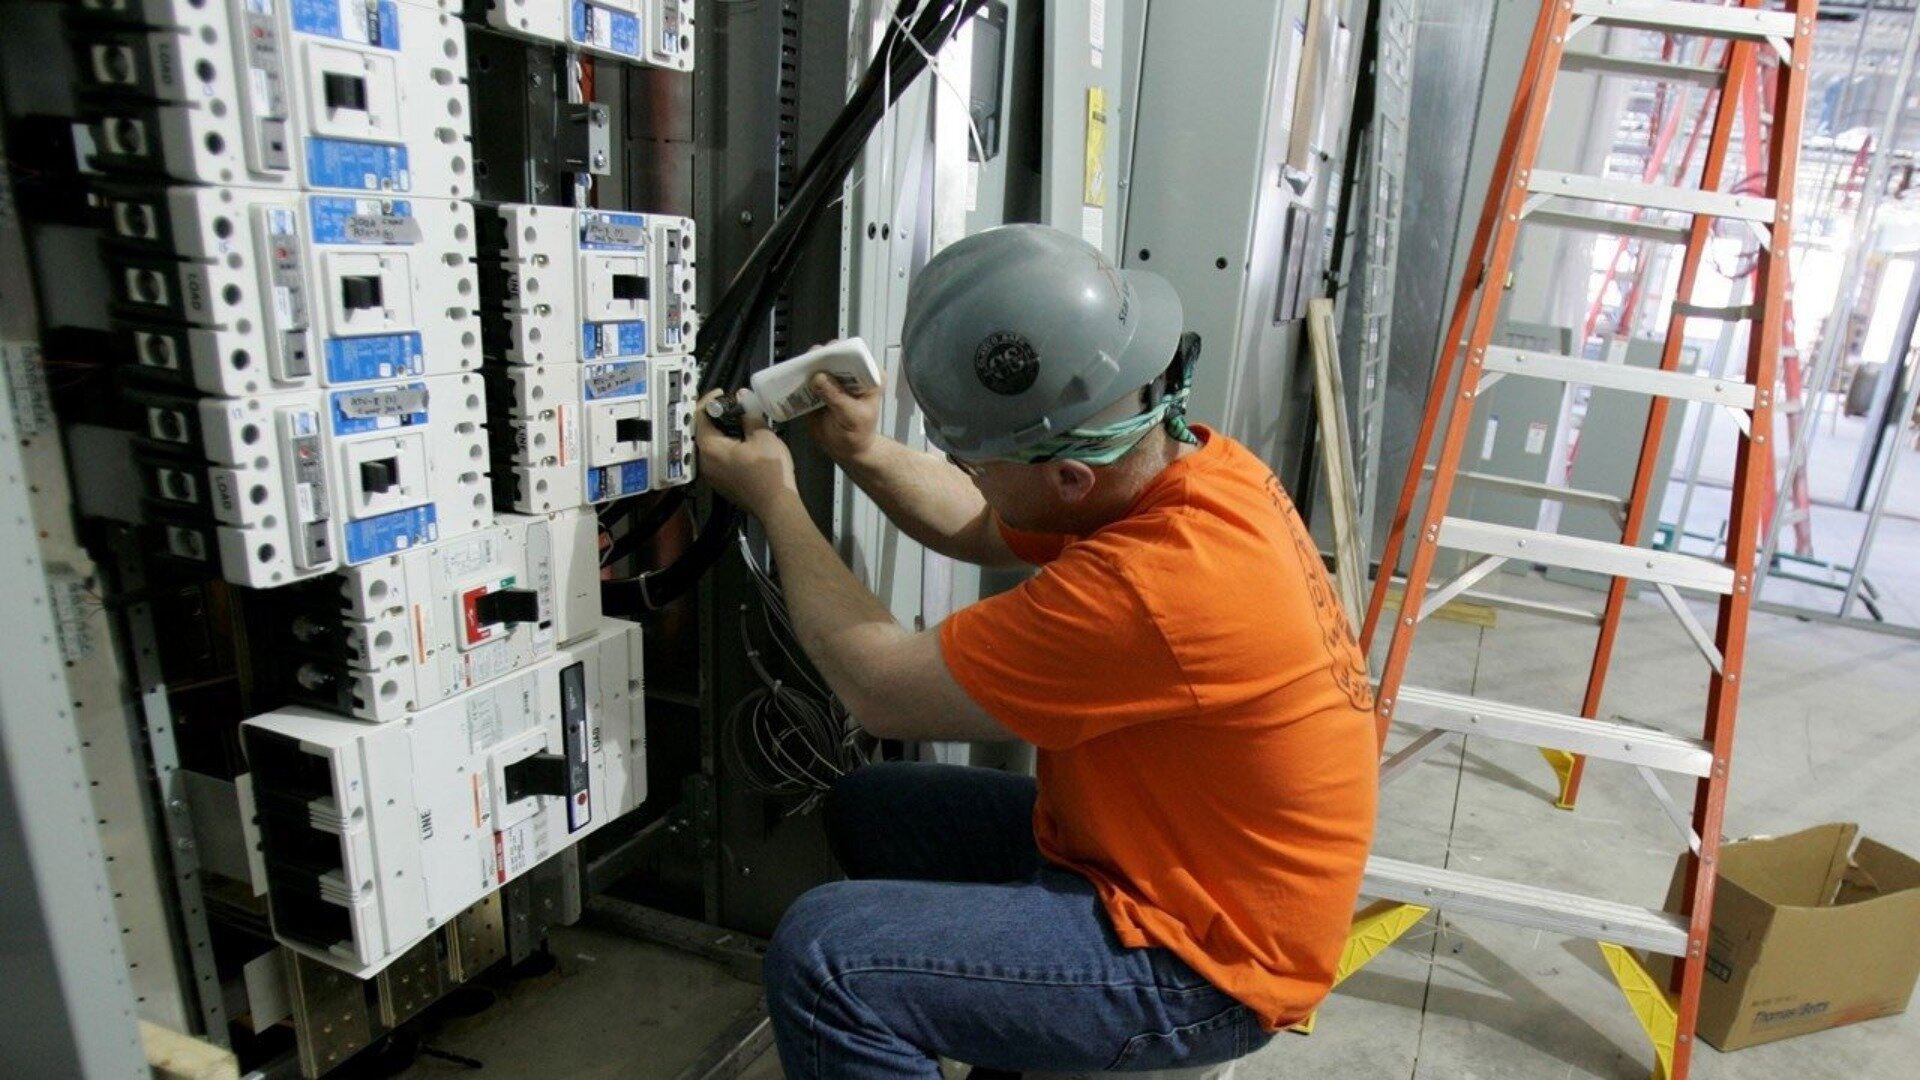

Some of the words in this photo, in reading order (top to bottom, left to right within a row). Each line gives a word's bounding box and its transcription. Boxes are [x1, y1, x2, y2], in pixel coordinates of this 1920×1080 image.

[158, 43, 173, 85] LOAD
[188, 273, 202, 311] LOAD
[215, 475, 232, 511] LOAD
[592, 726, 601, 754] LOAD
[420, 809, 434, 841] LINE
